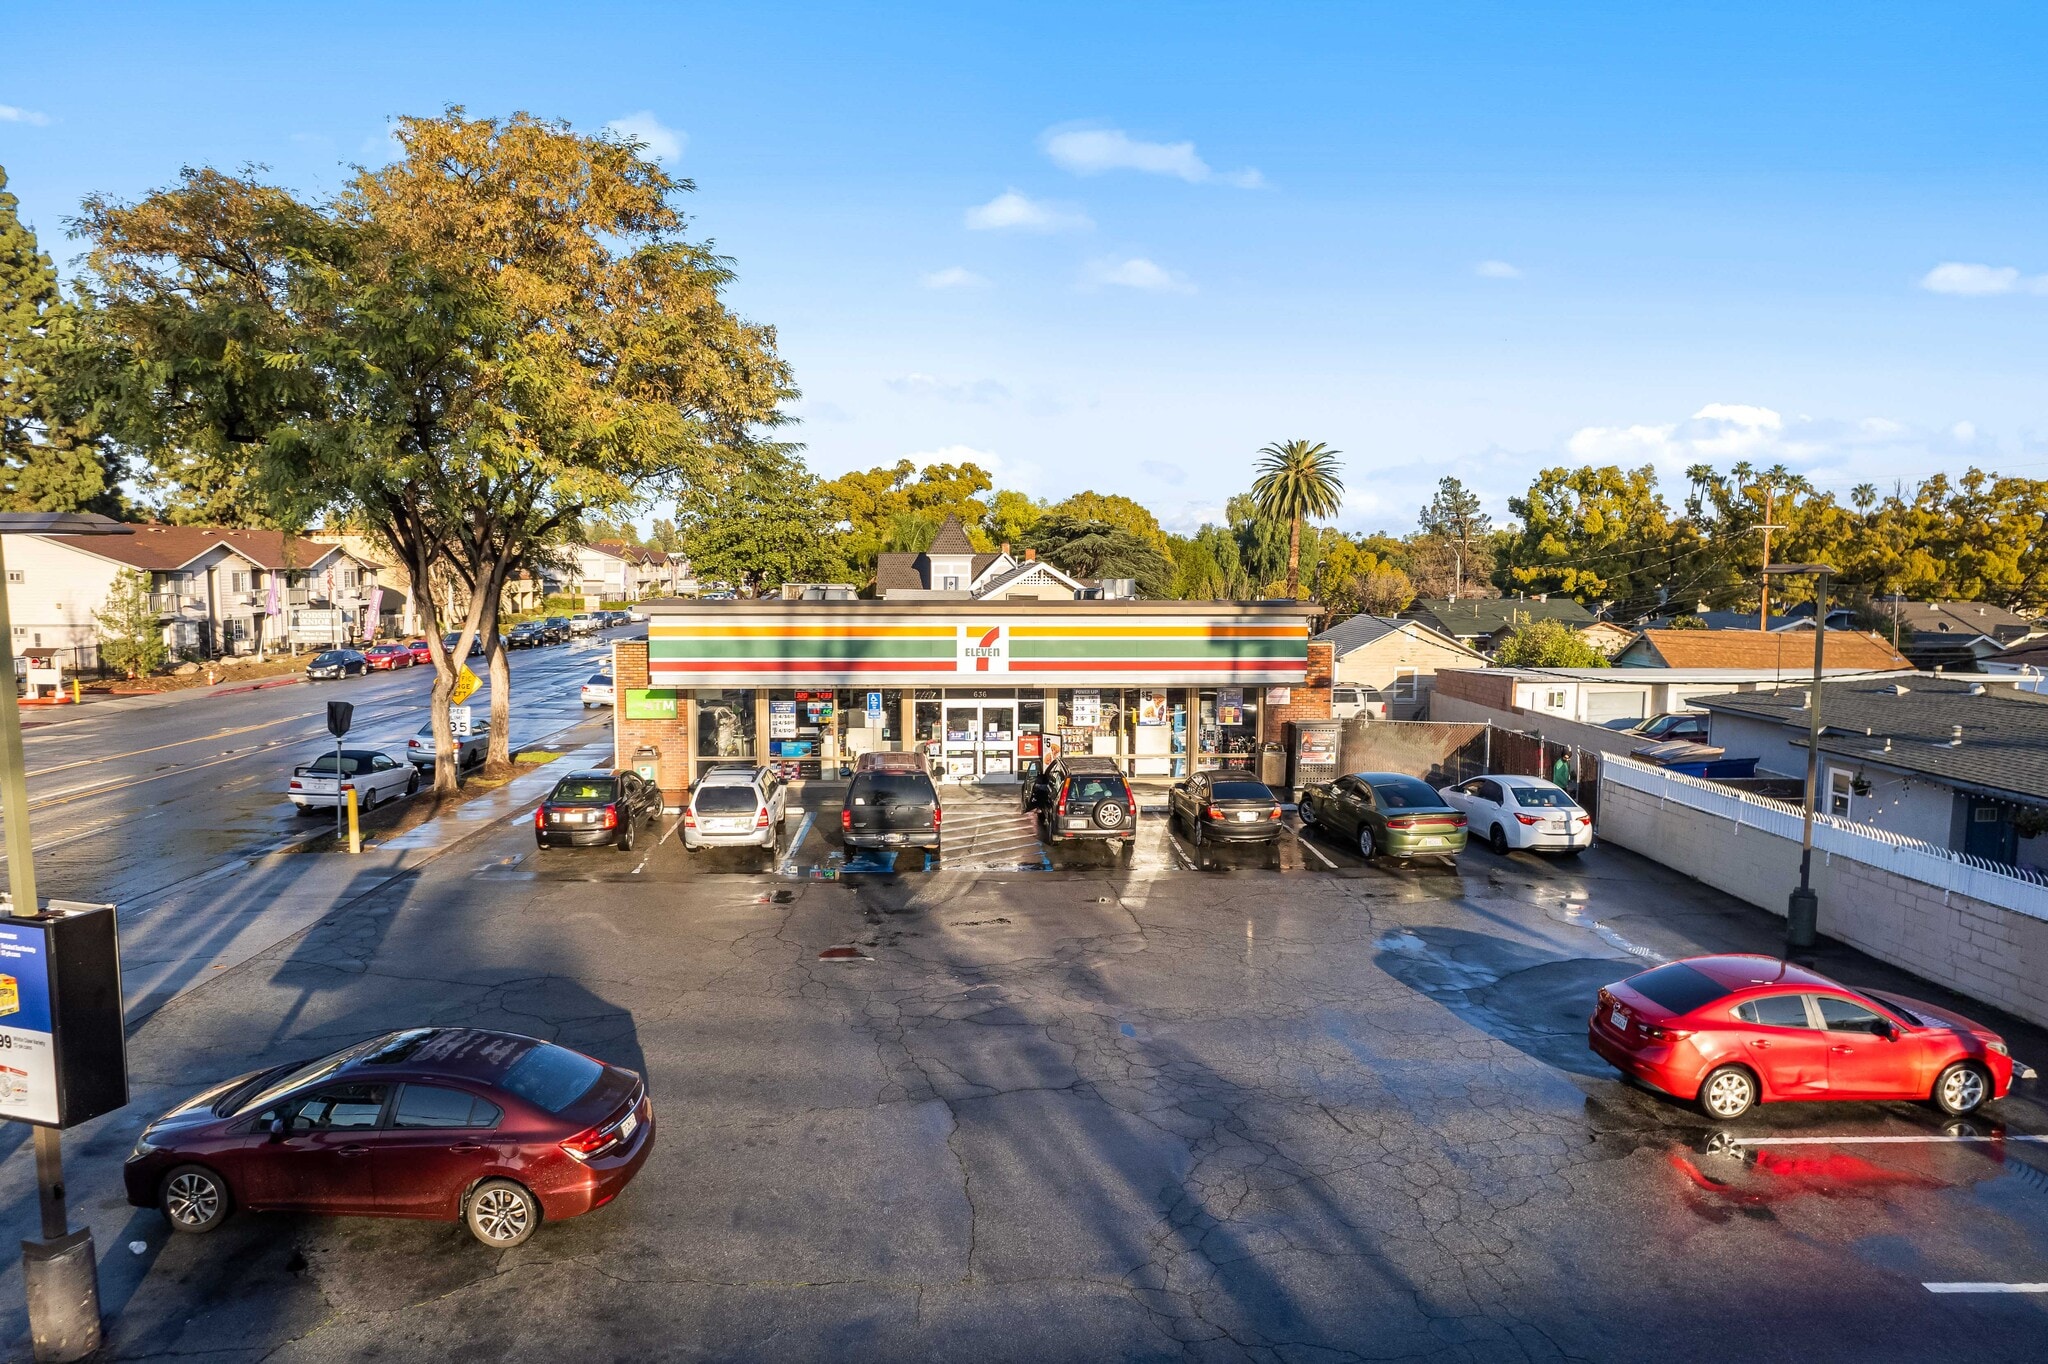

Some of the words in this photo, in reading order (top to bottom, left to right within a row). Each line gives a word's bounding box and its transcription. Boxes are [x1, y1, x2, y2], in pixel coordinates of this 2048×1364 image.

[1141, 691, 1153, 702] $5
[644, 700, 675, 711] ATM
[449, 721, 467, 732] 35
